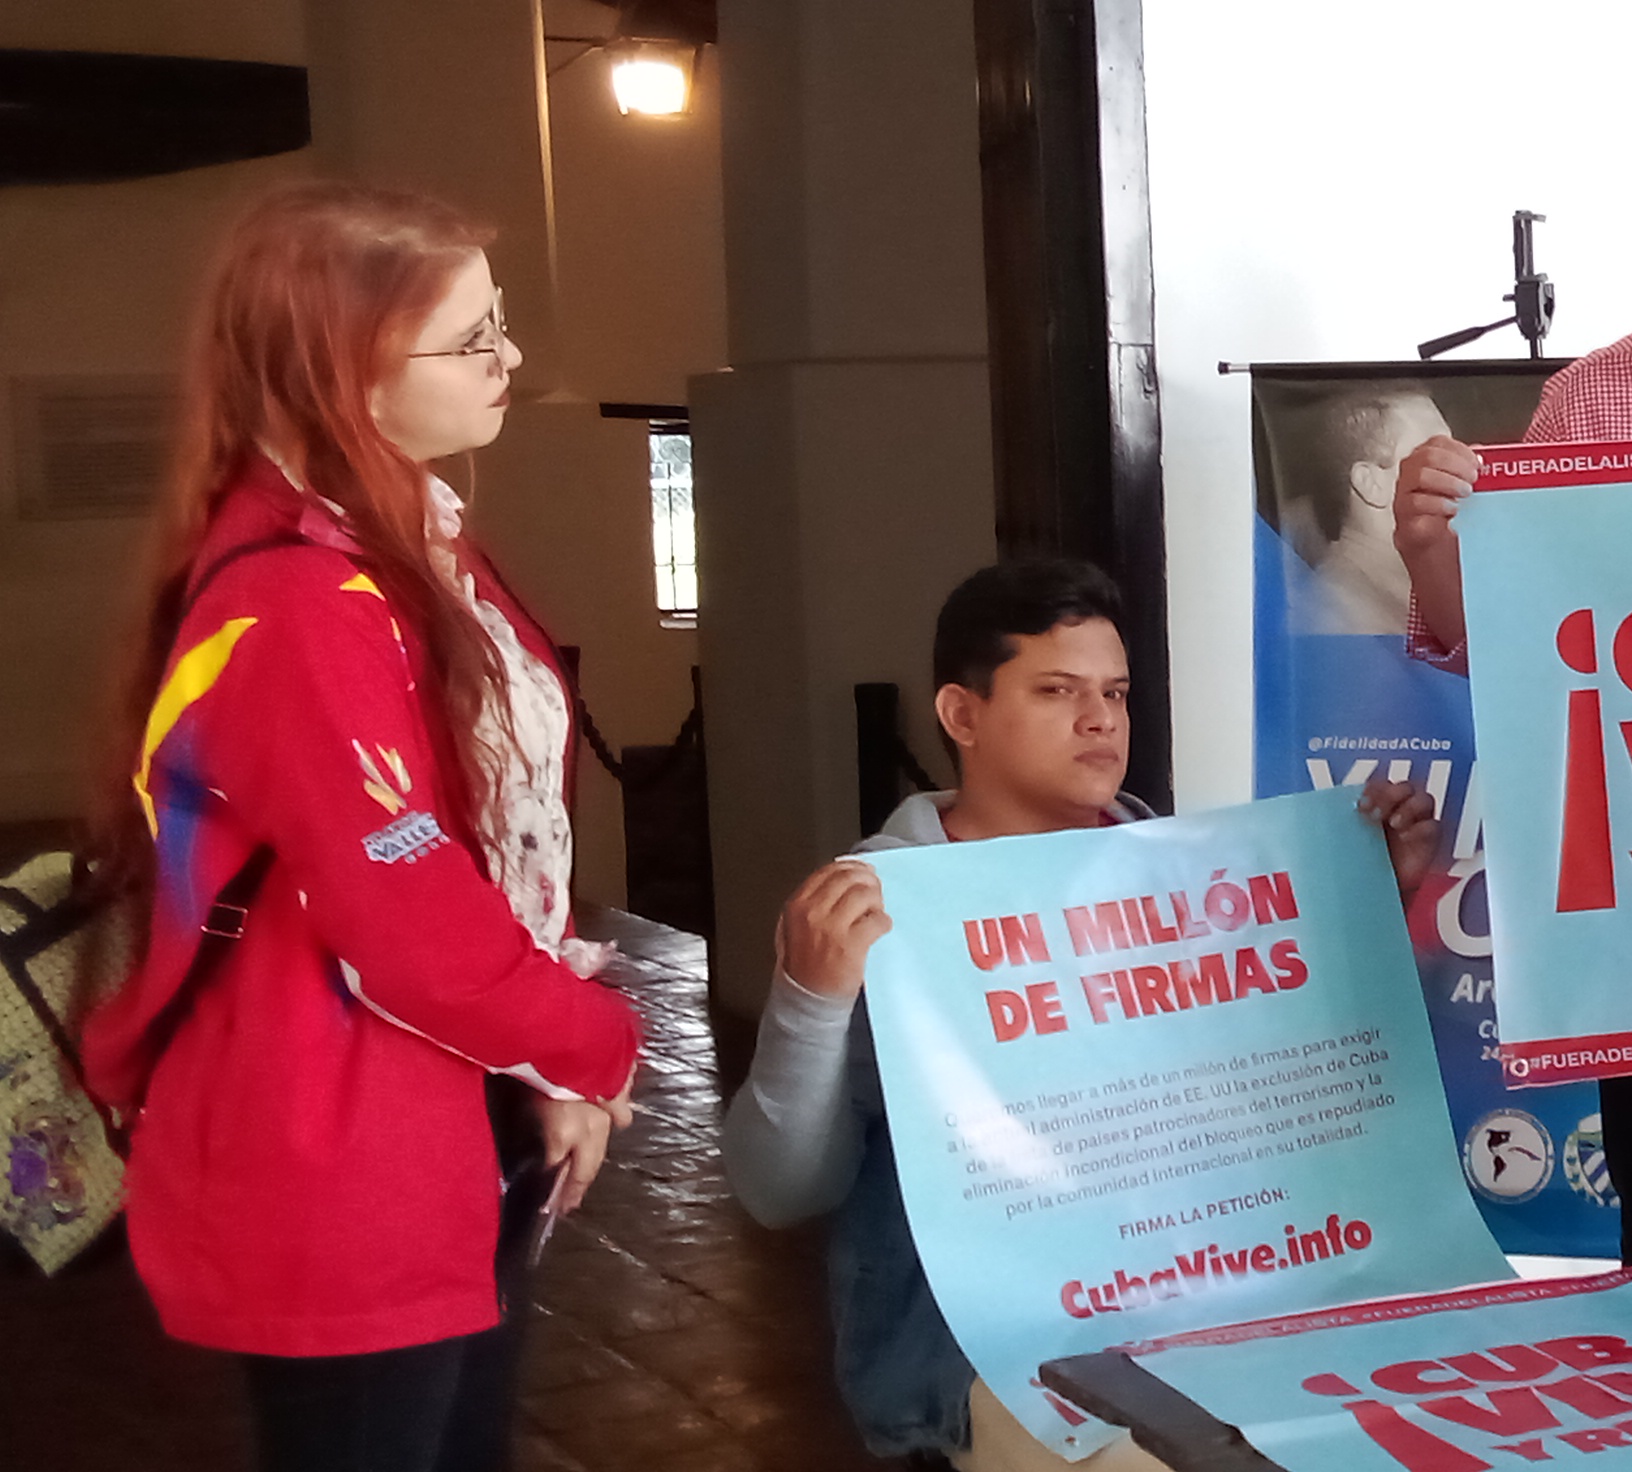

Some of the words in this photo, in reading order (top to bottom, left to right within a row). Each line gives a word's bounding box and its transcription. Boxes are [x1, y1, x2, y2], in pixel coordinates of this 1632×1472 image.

[1308, 737, 1452, 752] @FidelidadACuba
[963, 913, 1052, 971] UN
[1063, 868, 1299, 957] MILLÓN
[985, 981, 1069, 1043] DE
[1081, 939, 1309, 1024] FIRMAS
[1037, 1089, 1085, 1110] llegar
[1089, 1087, 1099, 1099] a
[1103, 1077, 1137, 1096] más
[1139, 1072, 1160, 1088] de
[1162, 1071, 1181, 1084] un
[1183, 1060, 1226, 1079] millón
[1229, 1056, 1248, 1072] de
[1251, 1046, 1299, 1066] firmas
[1302, 1037, 1337, 1058] para
[1340, 1026, 1382, 1047] exigir
[1040, 1097, 1159, 1134] administración
[1163, 1092, 1181, 1108] de
[1235, 1079, 1248, 1093] la
[1251, 1065, 1324, 1090] exclusión
[1327, 1058, 1346, 1073] de
[1349, 1048, 1389, 1067] Cuba
[966, 1159, 987, 1174] de
[1053, 1141, 1074, 1156] de
[1133, 1104, 1246, 1140] patrocinadores
[1249, 1097, 1272, 1114] del
[1274, 1081, 1354, 1109] terrorismo
[1356, 1077, 1366, 1092] y
[1368, 1072, 1383, 1086] la
[1064, 1143, 1174, 1178] incondicional
[1178, 1136, 1202, 1153] del
[1205, 1123, 1263, 1149] bloqueo
[1266, 1116, 1294, 1135] que
[1297, 1112, 1316, 1126] es
[1318, 1093, 1395, 1122] repudiado
[1005, 1200, 1034, 1221] por
[1038, 1194, 1054, 1209] la
[1057, 1171, 1150, 1205] comunidad
[1153, 1148, 1252, 1182] internacional
[1256, 1145, 1274, 1159] en
[1277, 1139, 1294, 1154] su
[1297, 1122, 1368, 1149] totalidad.
[1118, 1214, 1177, 1240] FIRMA
[1180, 1207, 1203, 1226] LA
[1206, 1187, 1290, 1218] PETICIÓN:
[1061, 1213, 1372, 1319] CubaVive.info
[1491, 1439, 1554, 1462] Y
